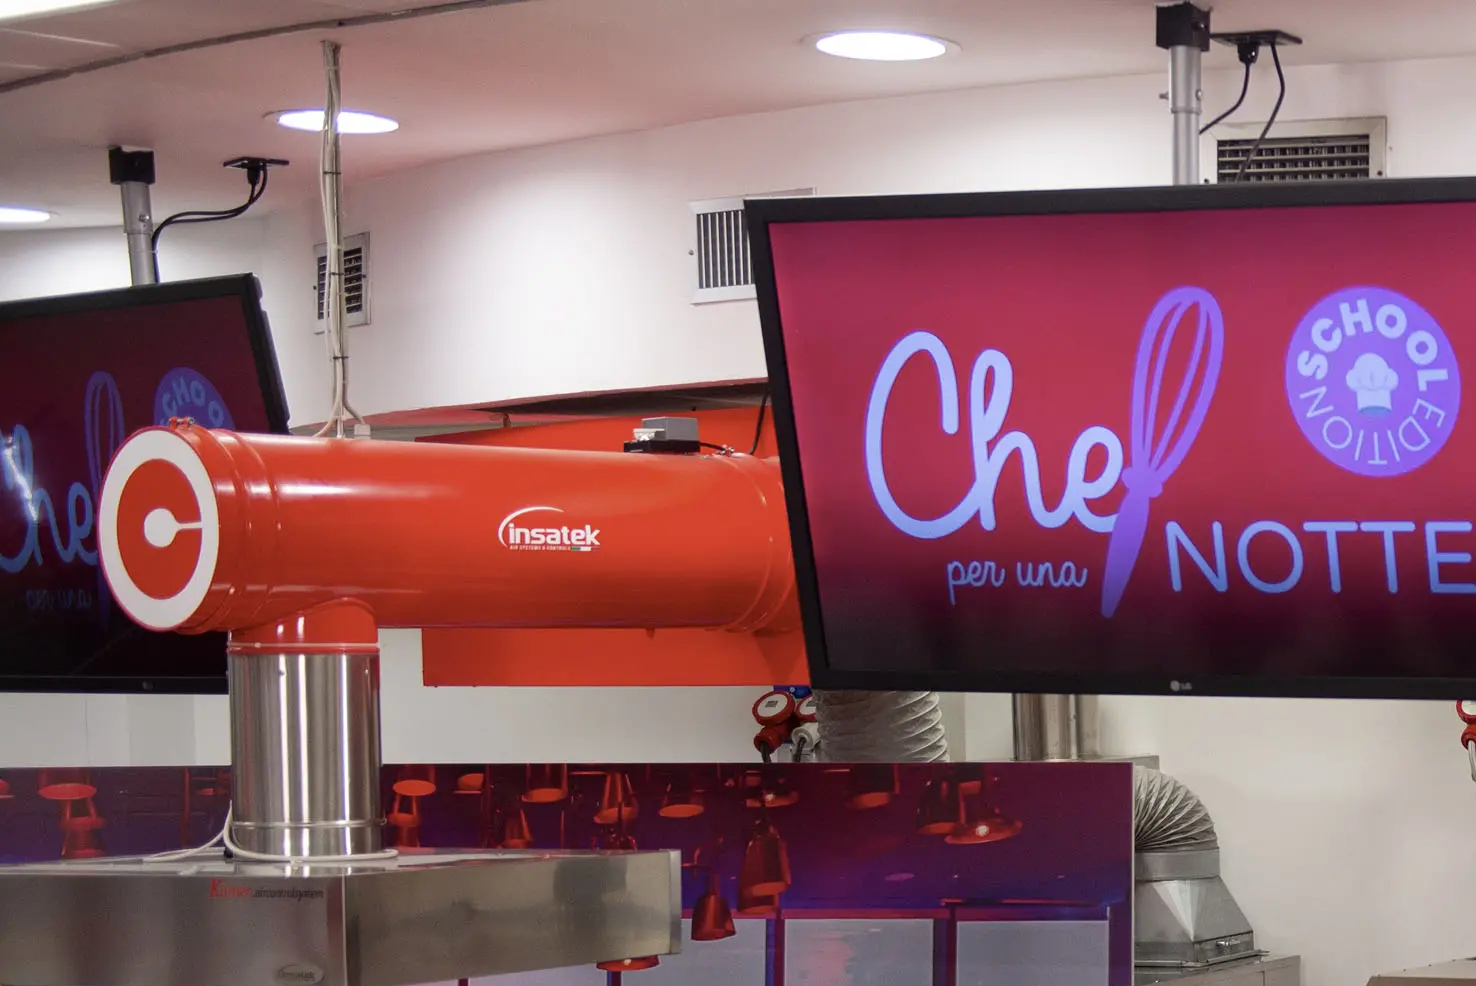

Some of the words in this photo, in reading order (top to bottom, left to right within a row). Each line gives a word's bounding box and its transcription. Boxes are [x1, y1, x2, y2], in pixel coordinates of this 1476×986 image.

[1297, 298, 1448, 392] SCHOOL
[865, 286, 1224, 618] Chef
[1300, 386, 1447, 465] EDITION
[947, 559, 1005, 605] per
[1016, 559, 1087, 588] una
